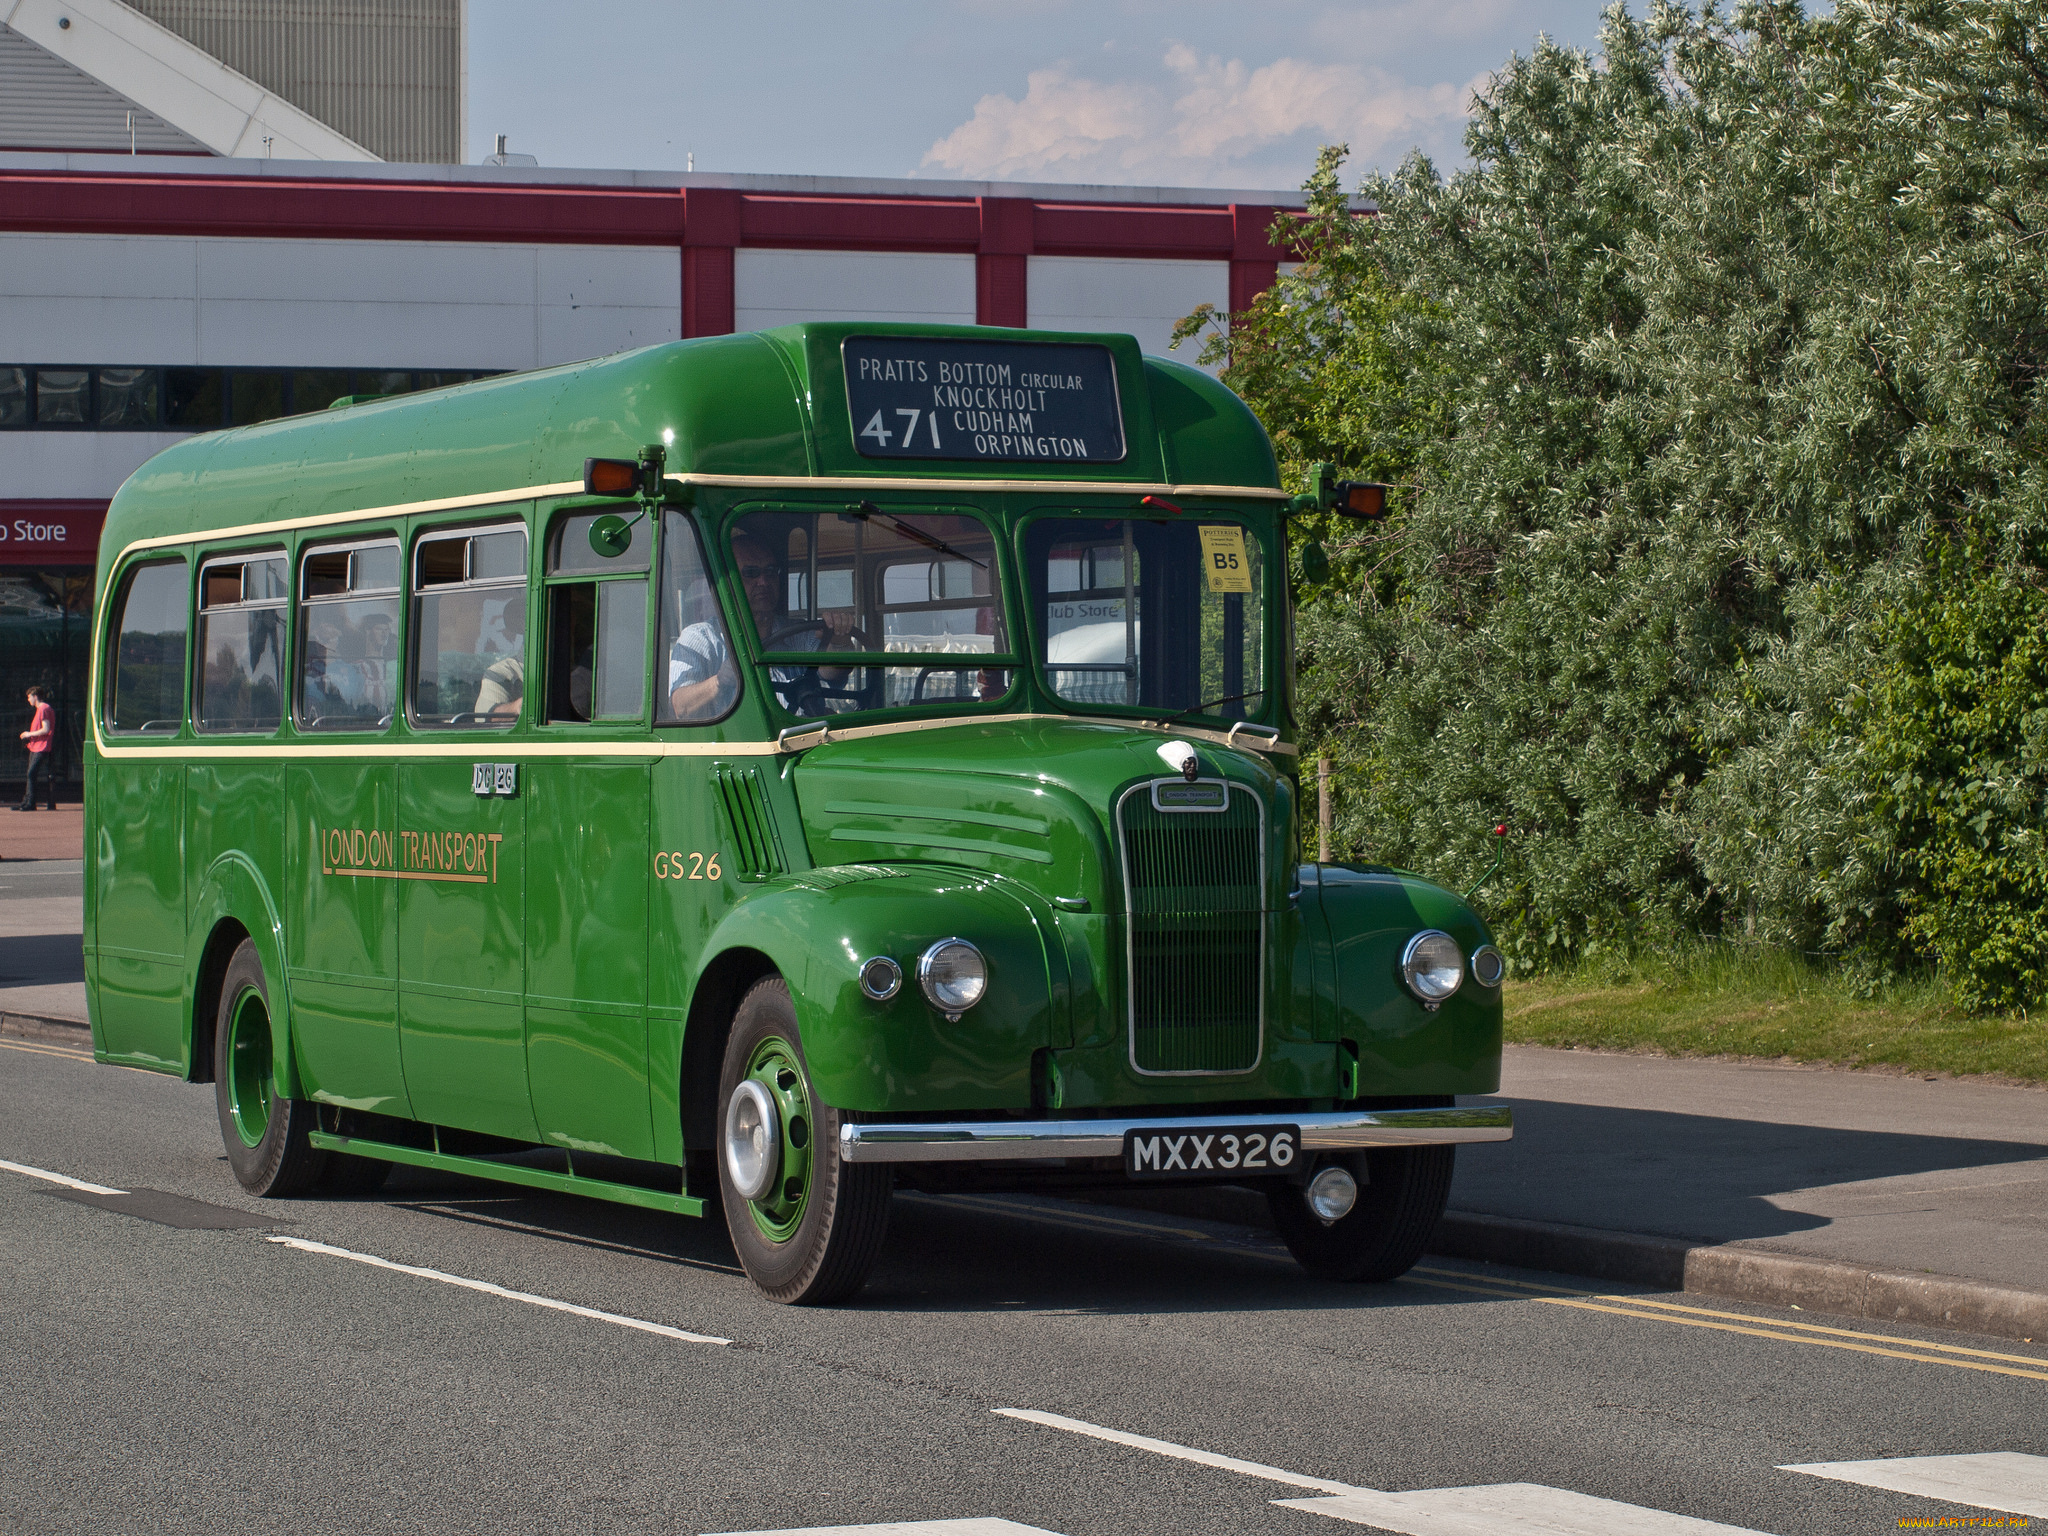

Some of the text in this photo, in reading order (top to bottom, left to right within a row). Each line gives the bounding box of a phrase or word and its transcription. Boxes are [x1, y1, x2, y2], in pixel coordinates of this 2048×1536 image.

[860, 358, 1083, 391] PRATTS BOTTOM CIRCULAR
[933, 385, 1046, 412] KNOCKHOLT
[859, 408, 941, 449] 471
[954, 411, 1033, 434] CUDHAM
[974, 434, 1088, 458] ORPINGTON
[14, 520, 66, 541] Store
[1213, 553, 1239, 569] B5
[1048, 604, 1119, 619] lub Store
[322, 828, 502, 884] LONDON TRANSPORT
[653, 851, 722, 881] GS26
[1133, 1132, 1294, 1171] MXX326
